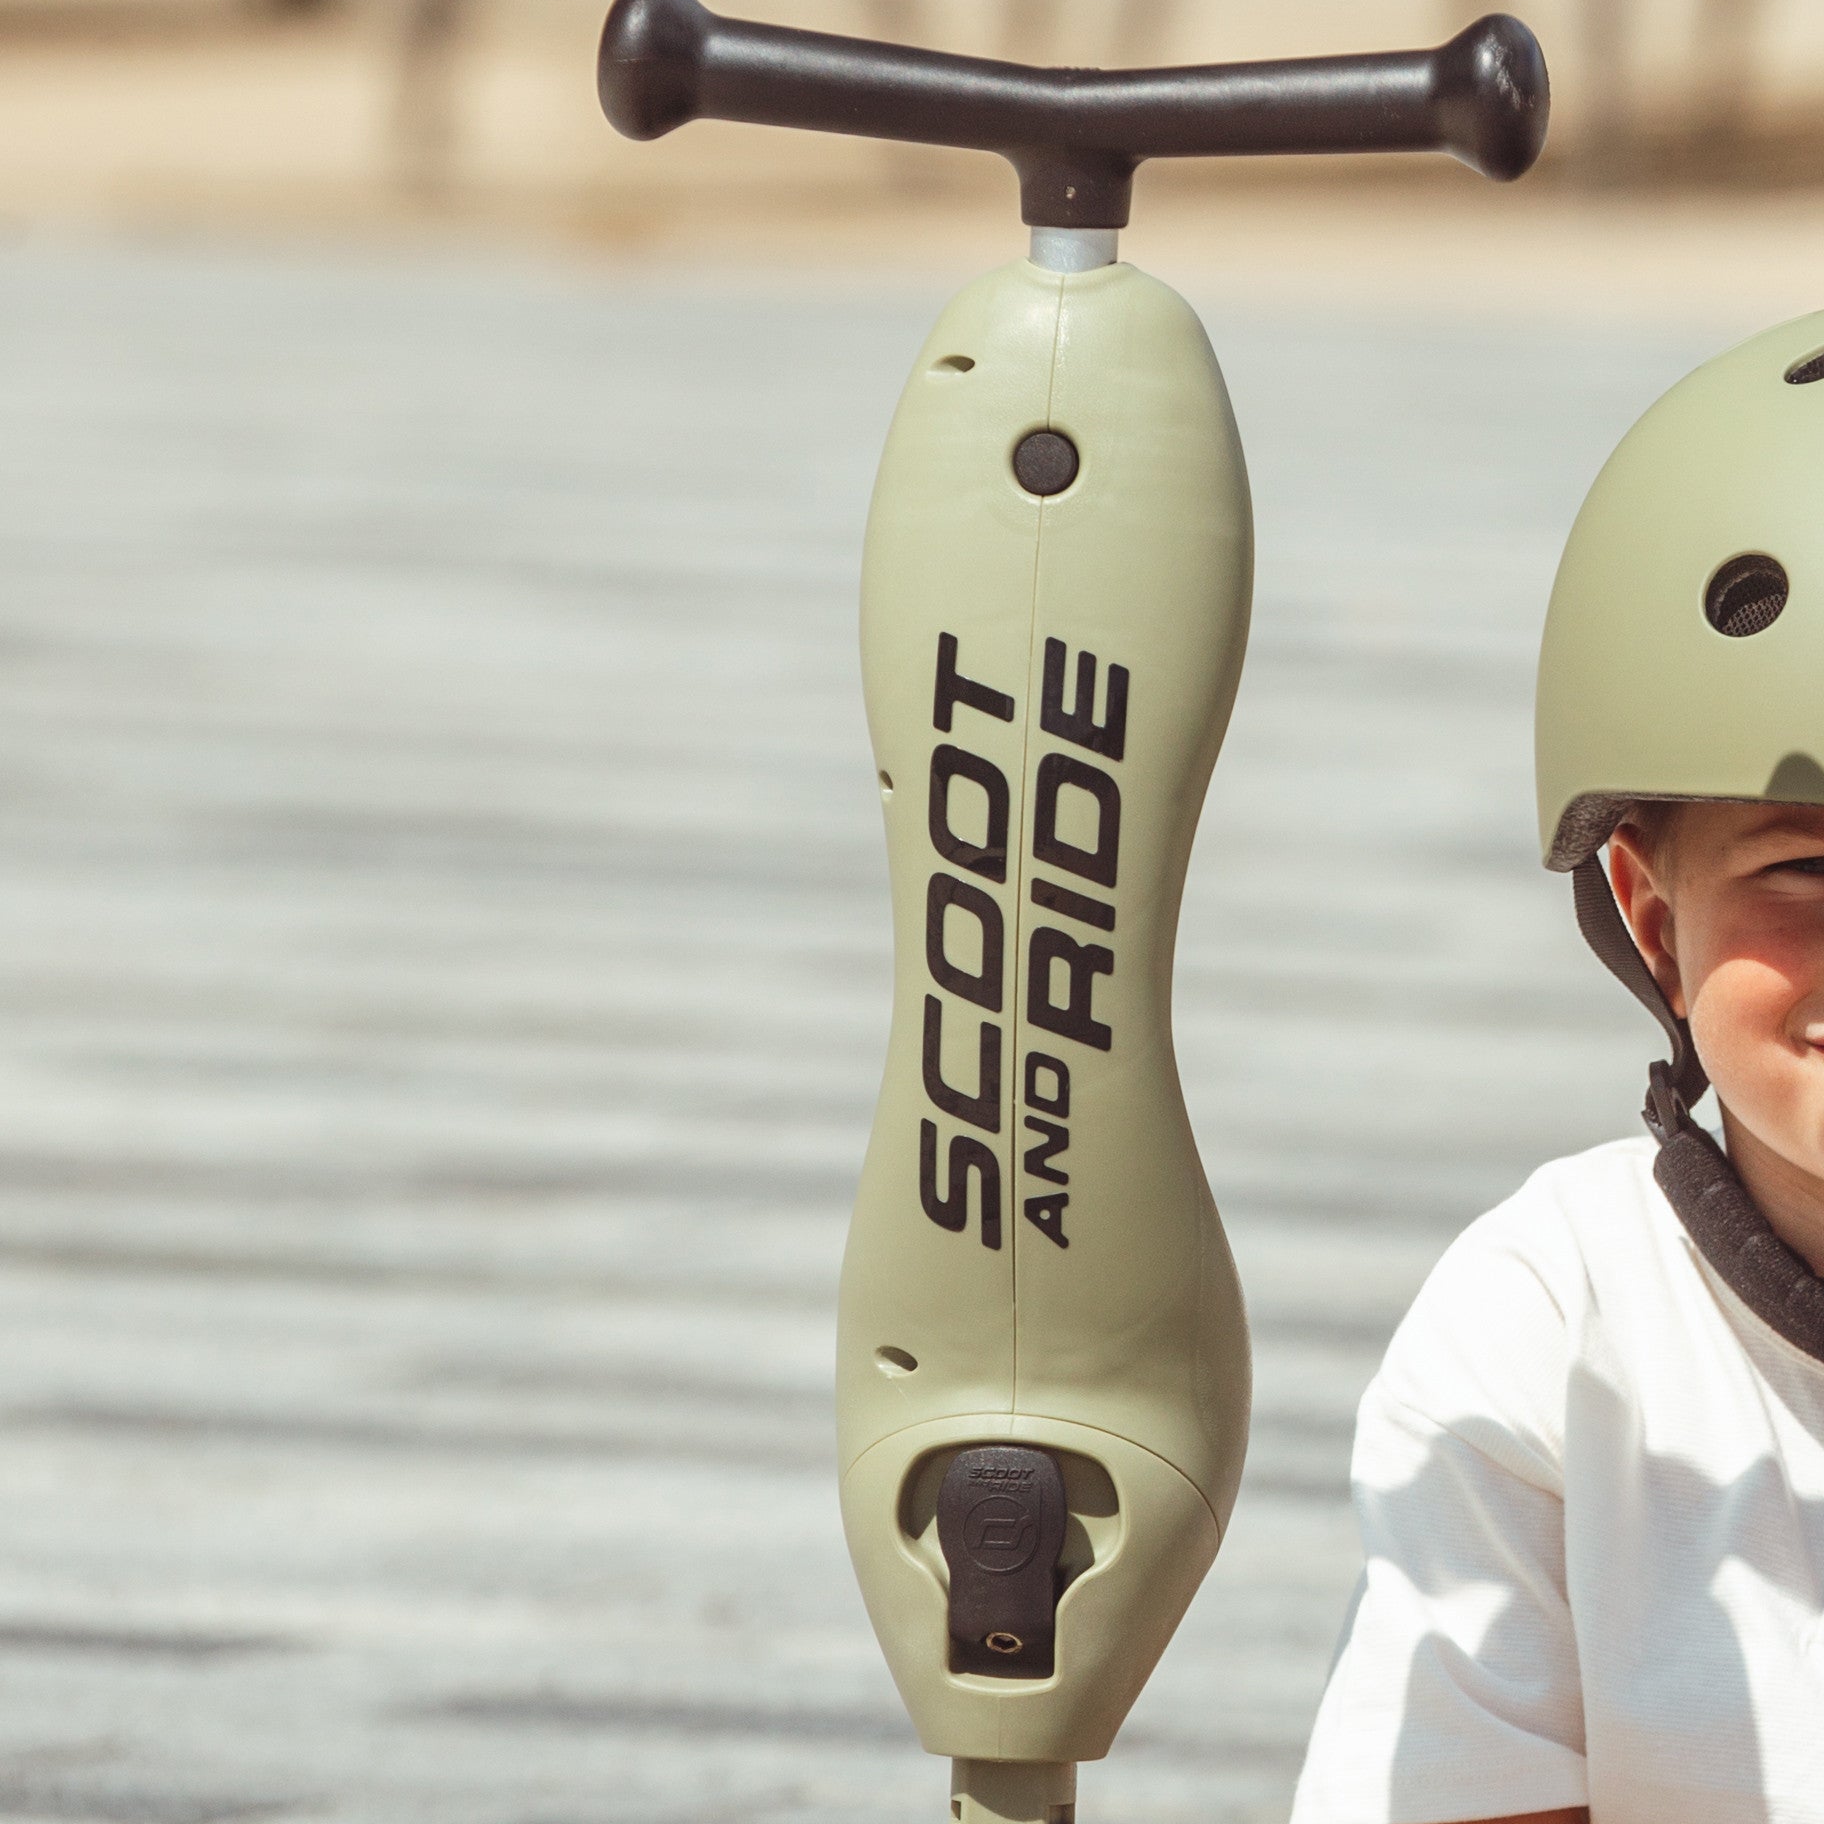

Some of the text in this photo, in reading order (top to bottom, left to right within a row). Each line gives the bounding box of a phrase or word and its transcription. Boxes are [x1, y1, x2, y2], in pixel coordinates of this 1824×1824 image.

[919, 631, 1015, 1250] SCOOT
[1024, 636, 1130, 1249] AND RIDE
[967, 1466, 1035, 1480] SCOOT
[988, 1480, 1034, 1493] RIDE
